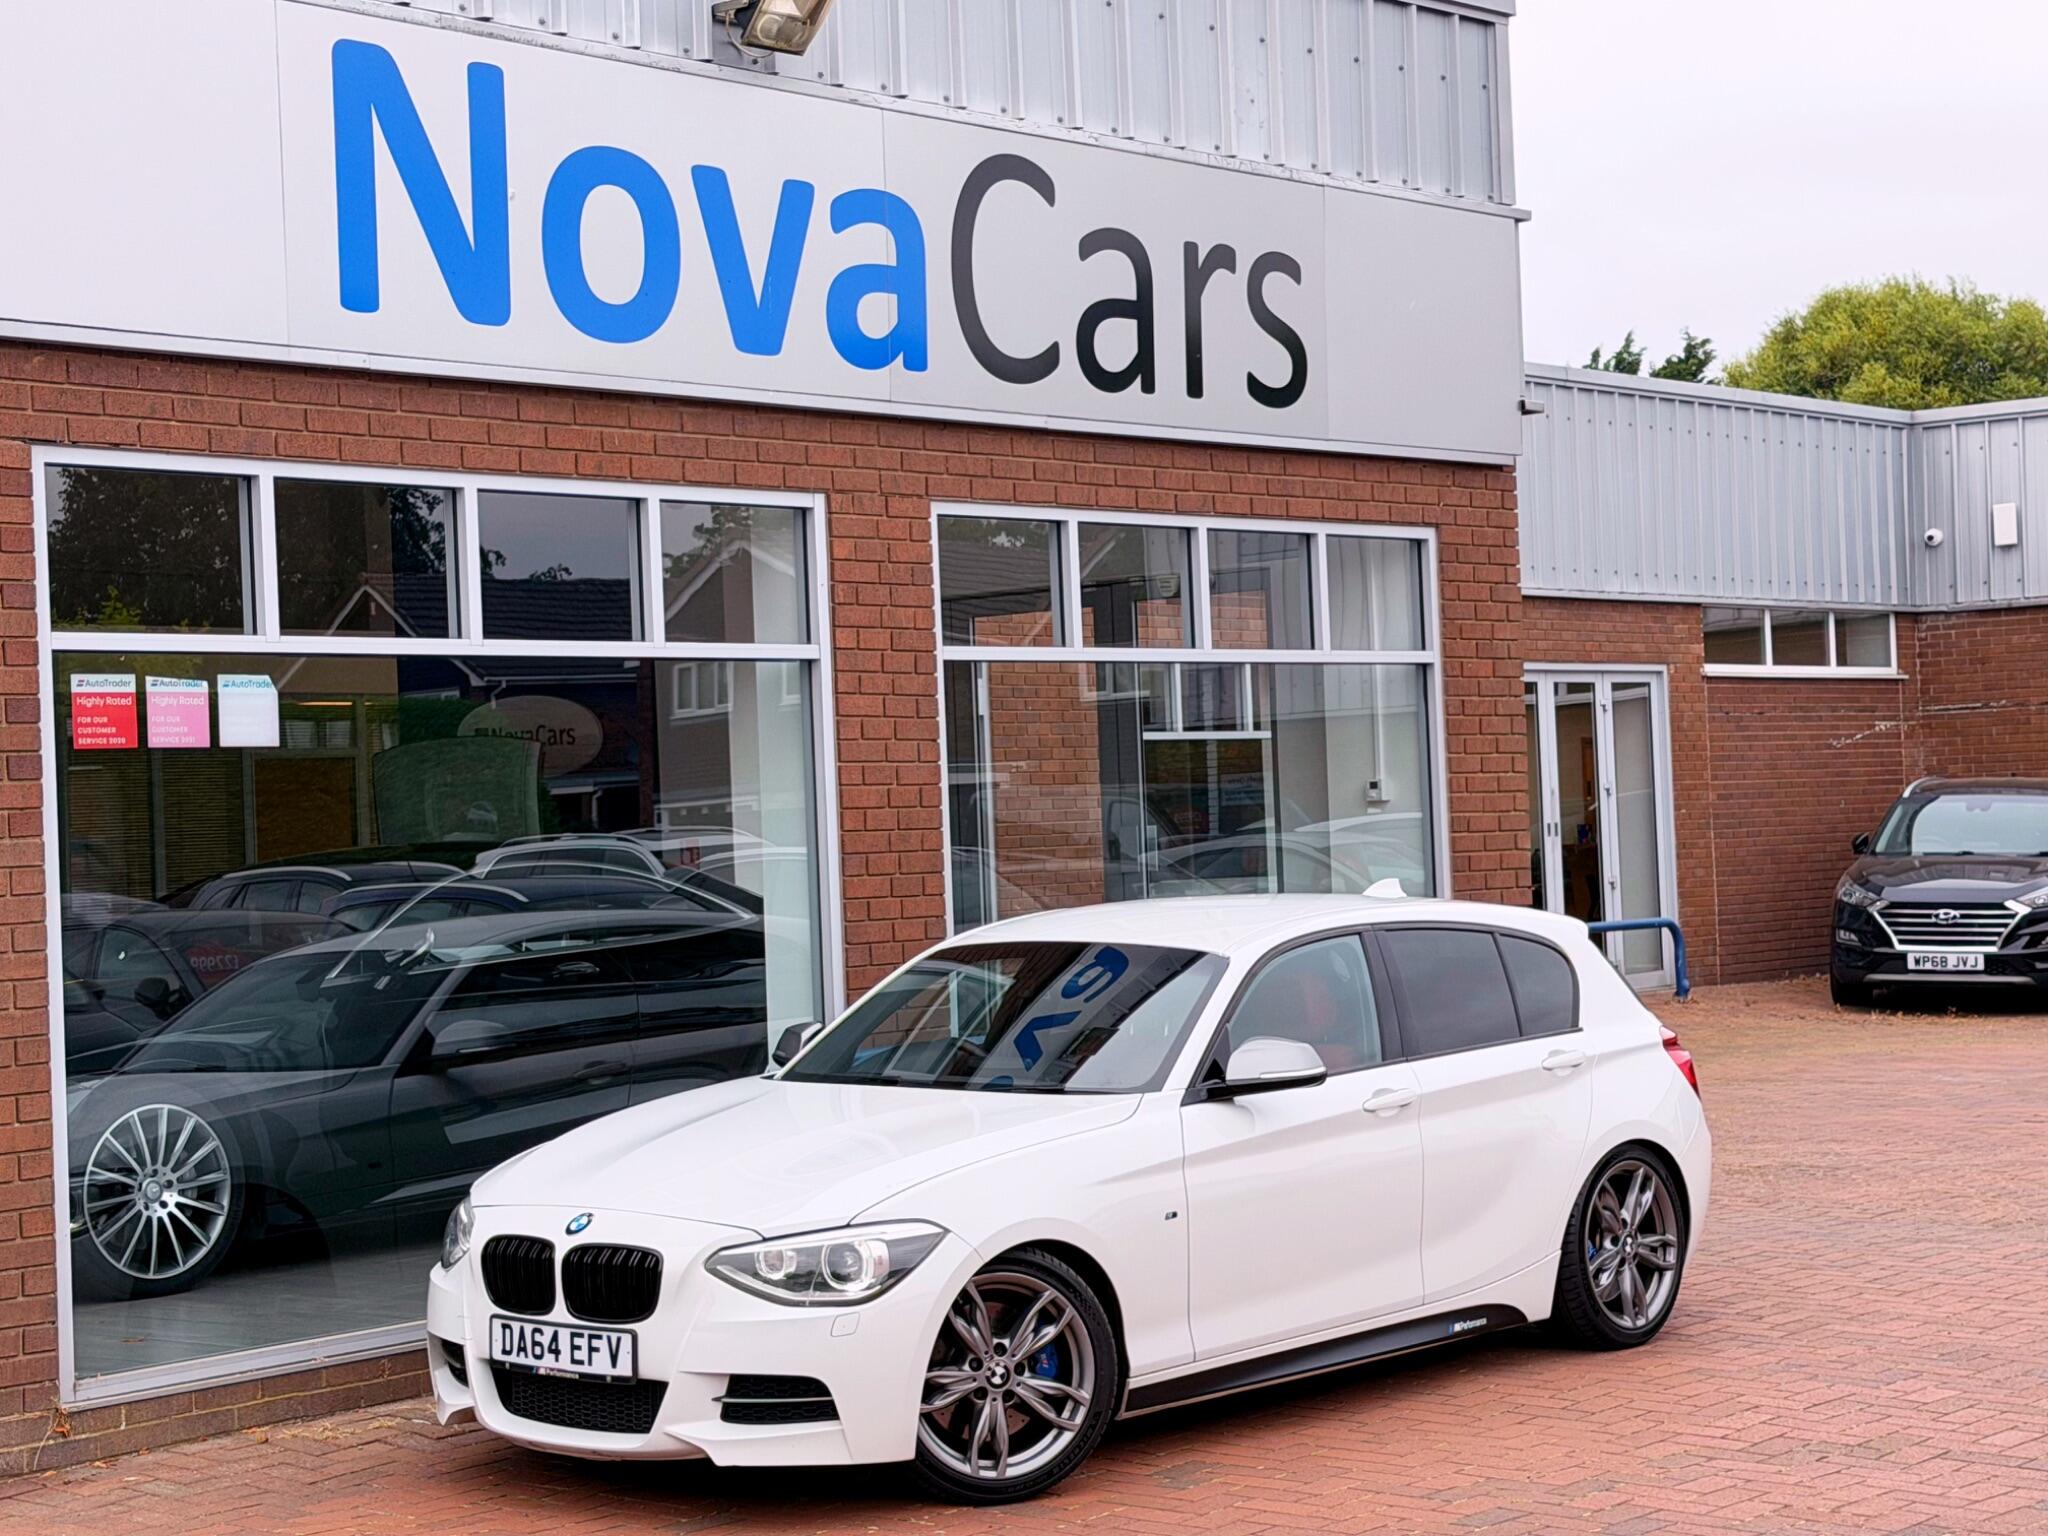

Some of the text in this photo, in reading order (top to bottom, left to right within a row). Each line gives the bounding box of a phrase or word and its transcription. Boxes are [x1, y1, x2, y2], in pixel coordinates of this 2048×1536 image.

[331, 38, 1308, 409] NovaCars
[85, 679, 132, 688] AutoTrader
[76, 696, 132, 708] Highly Rated
[151, 695, 204, 707] Highly Rated
[77, 716, 108, 724] FOR OUR
[77, 726, 116, 735] CUSTOMER
[78, 737, 107, 745] SERVICE
[1913, 955, 1978, 968] WP68 JVJ
[500, 1323, 622, 1369] DA64 EFV
